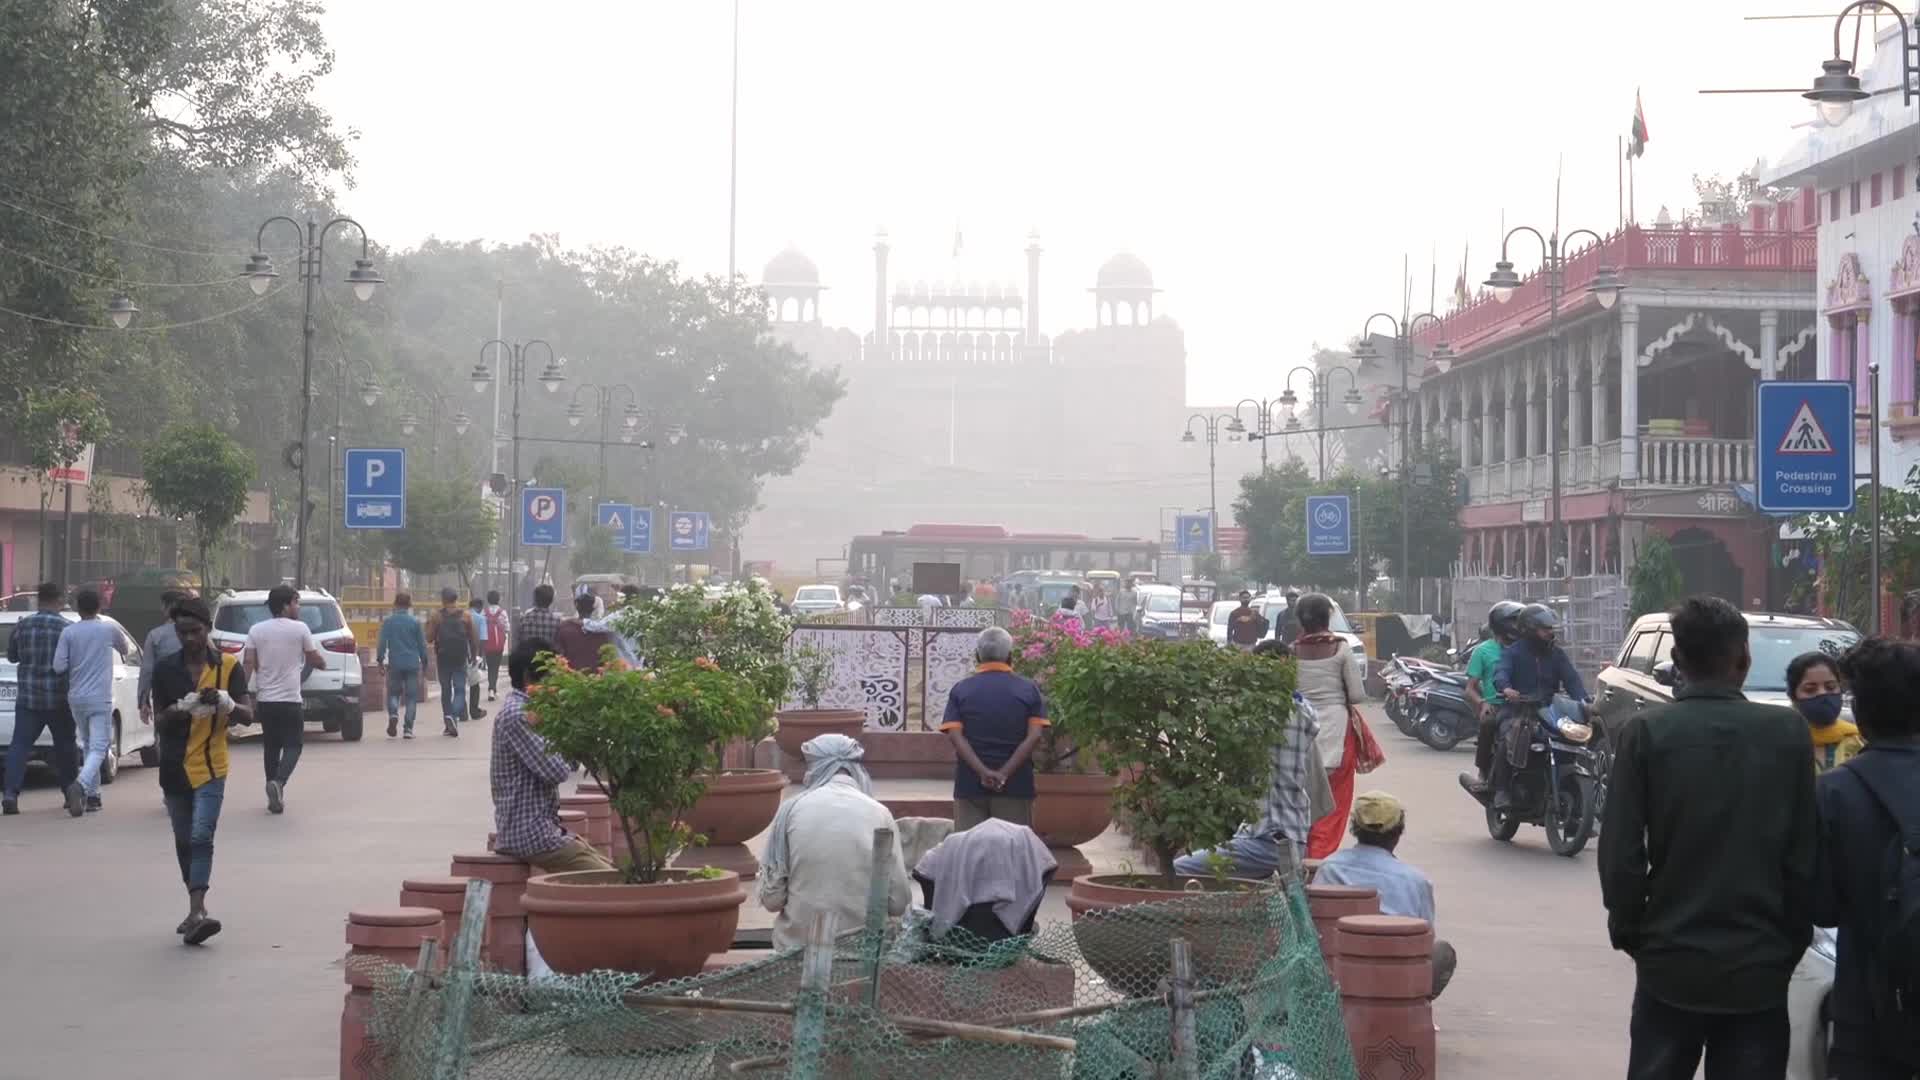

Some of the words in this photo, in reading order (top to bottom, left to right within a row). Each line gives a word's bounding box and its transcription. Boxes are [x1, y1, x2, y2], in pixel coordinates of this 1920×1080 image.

[367, 459, 385, 488] P
[1775, 471, 1837, 480] Pedestrian
[1780, 482, 1832, 495] Crossing
